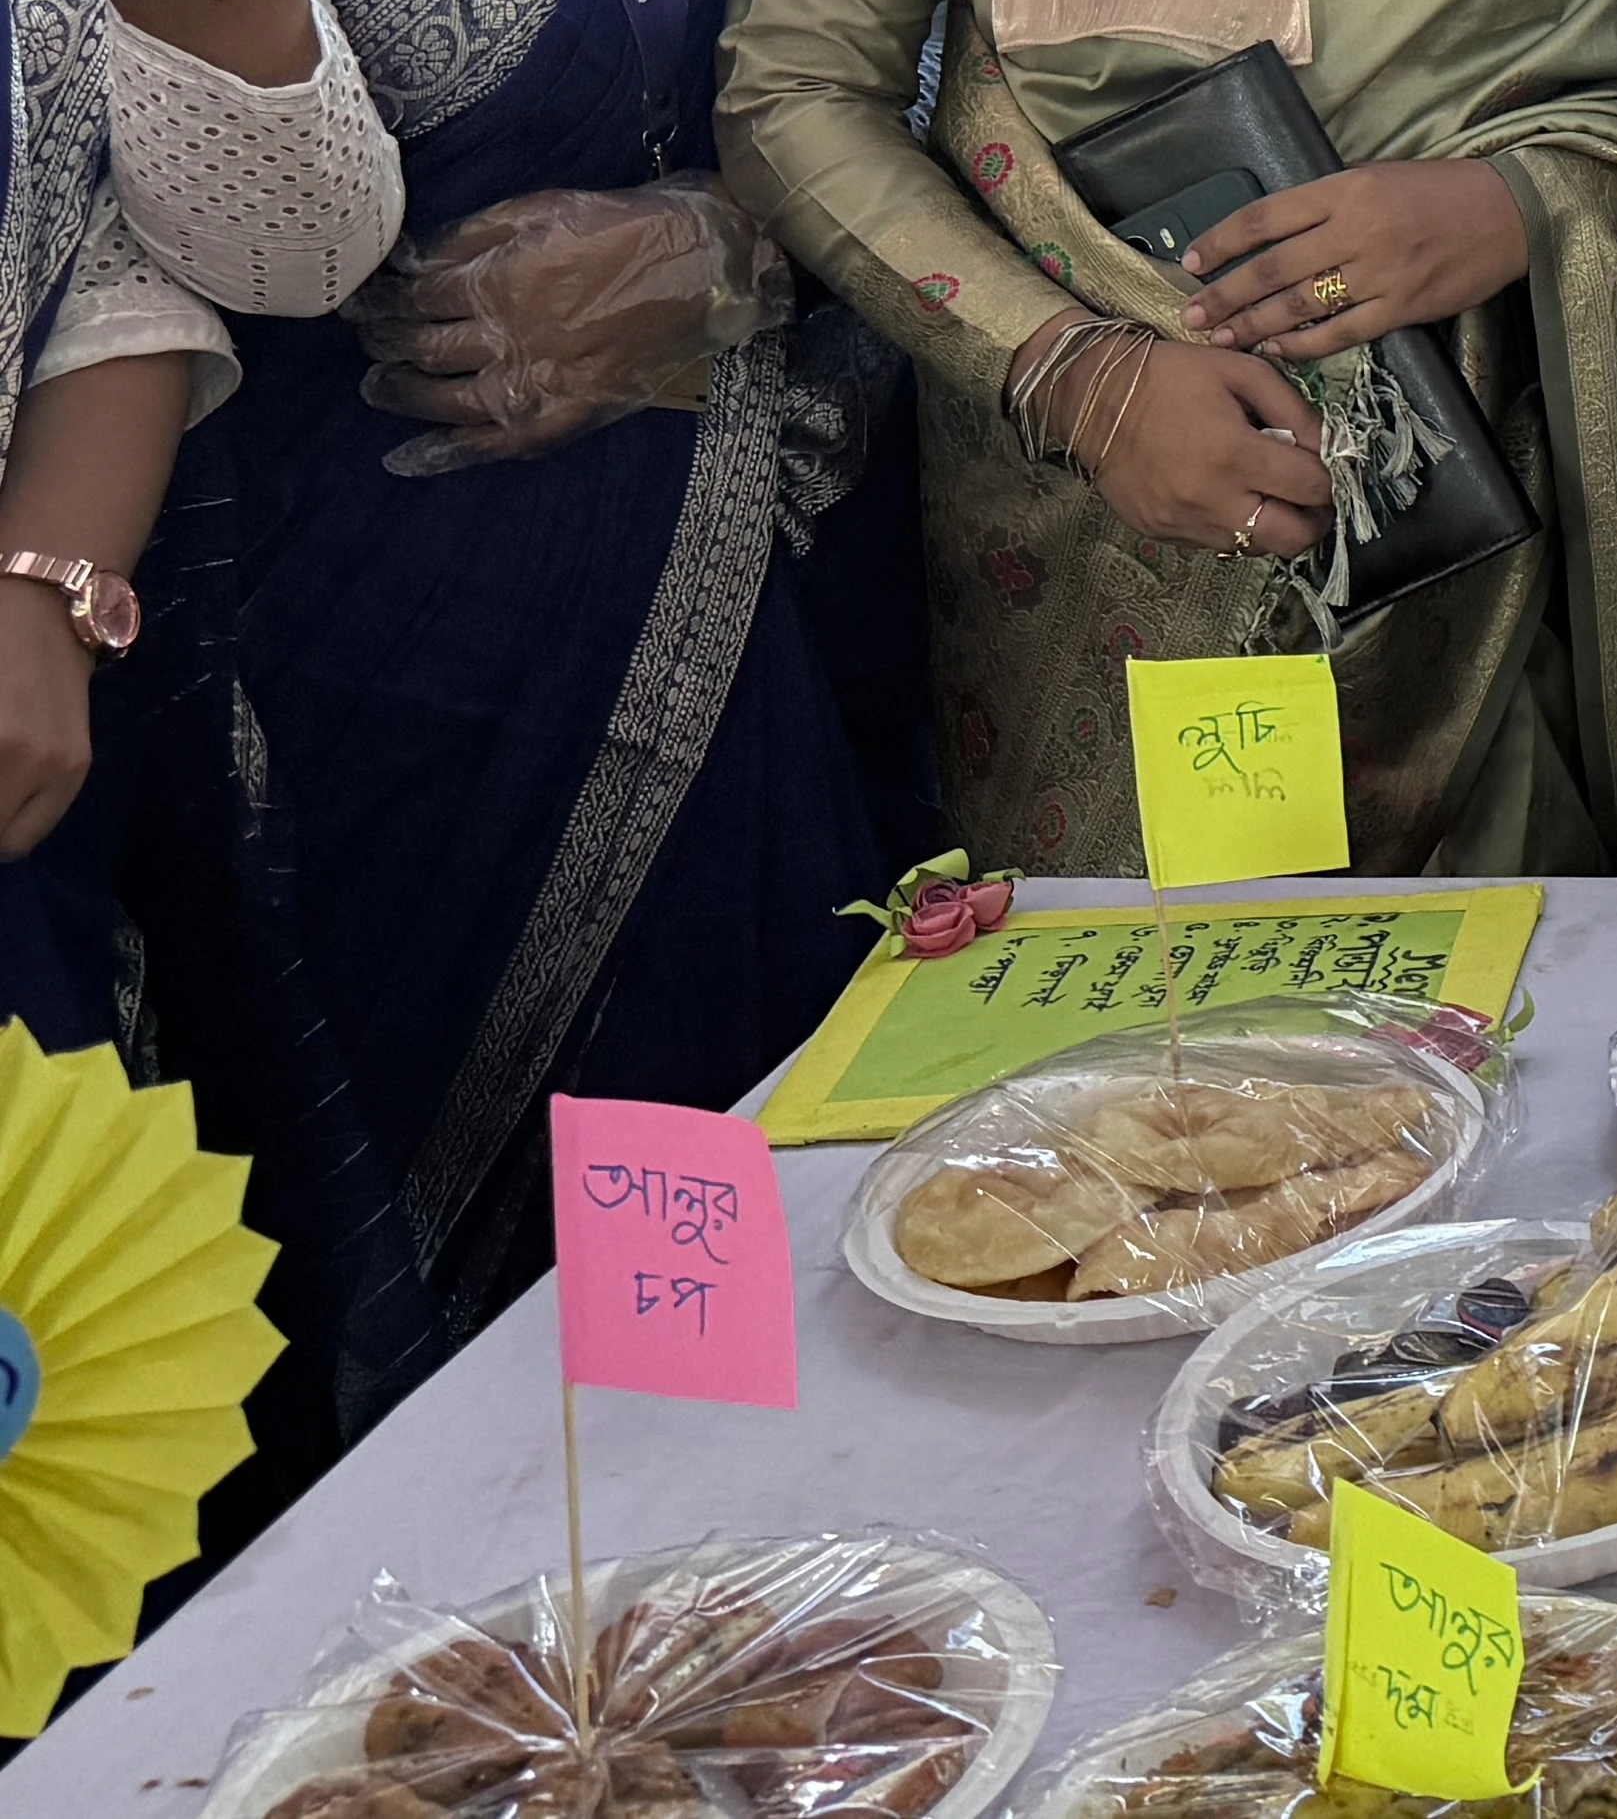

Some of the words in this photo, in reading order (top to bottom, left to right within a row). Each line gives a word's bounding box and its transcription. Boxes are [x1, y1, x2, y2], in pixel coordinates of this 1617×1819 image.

[1178, 700, 1286, 774] লুচি
[583, 1164, 738, 1265] আলুর
[634, 1270, 717, 1336] চপ
[1379, 1562, 1515, 1696] আলুর
[1377, 1665, 1443, 1731] দম
